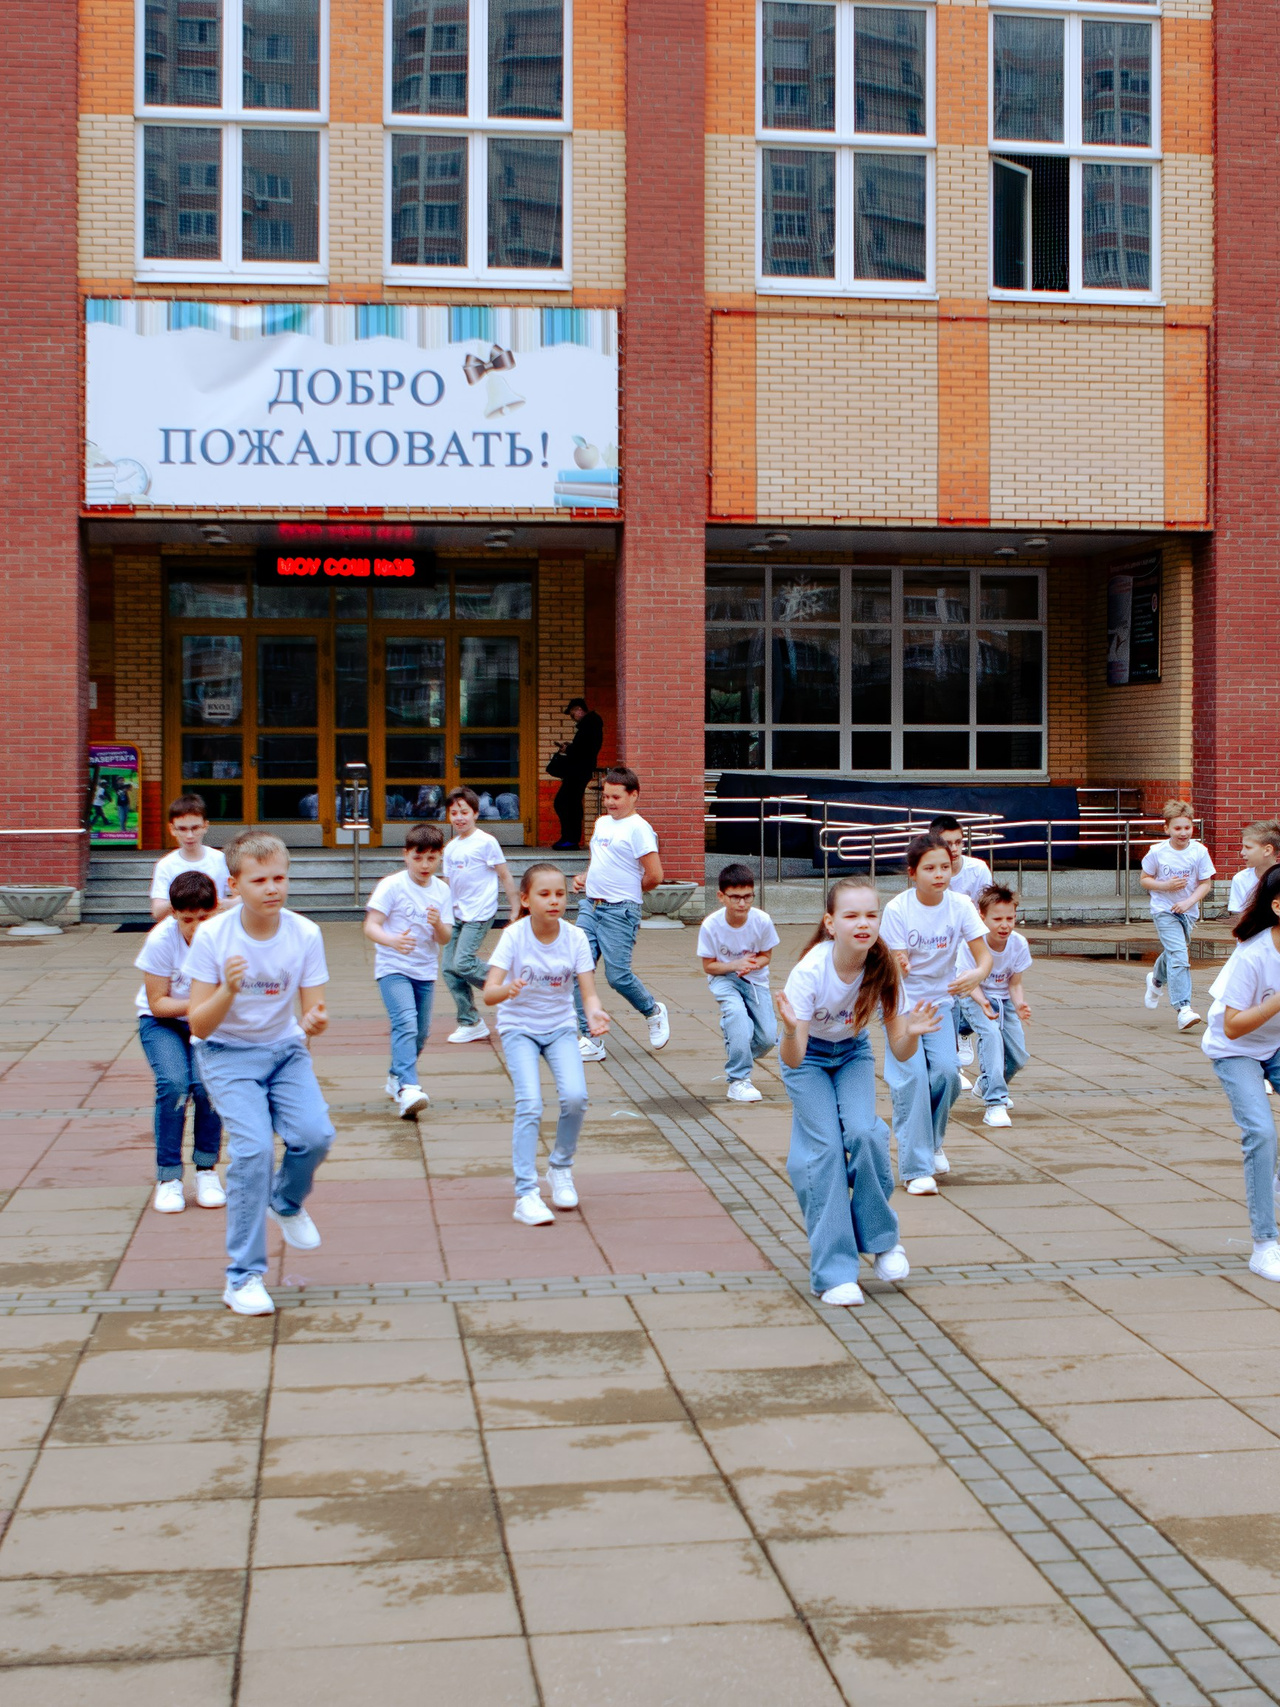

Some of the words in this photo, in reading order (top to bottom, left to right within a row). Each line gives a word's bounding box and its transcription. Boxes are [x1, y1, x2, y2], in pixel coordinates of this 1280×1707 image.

[268, 368, 446, 414] ДОБРО
[158, 428, 550, 468] ПОЖАЛОВАТЬ!
[323, 557, 371, 577] СОШ
